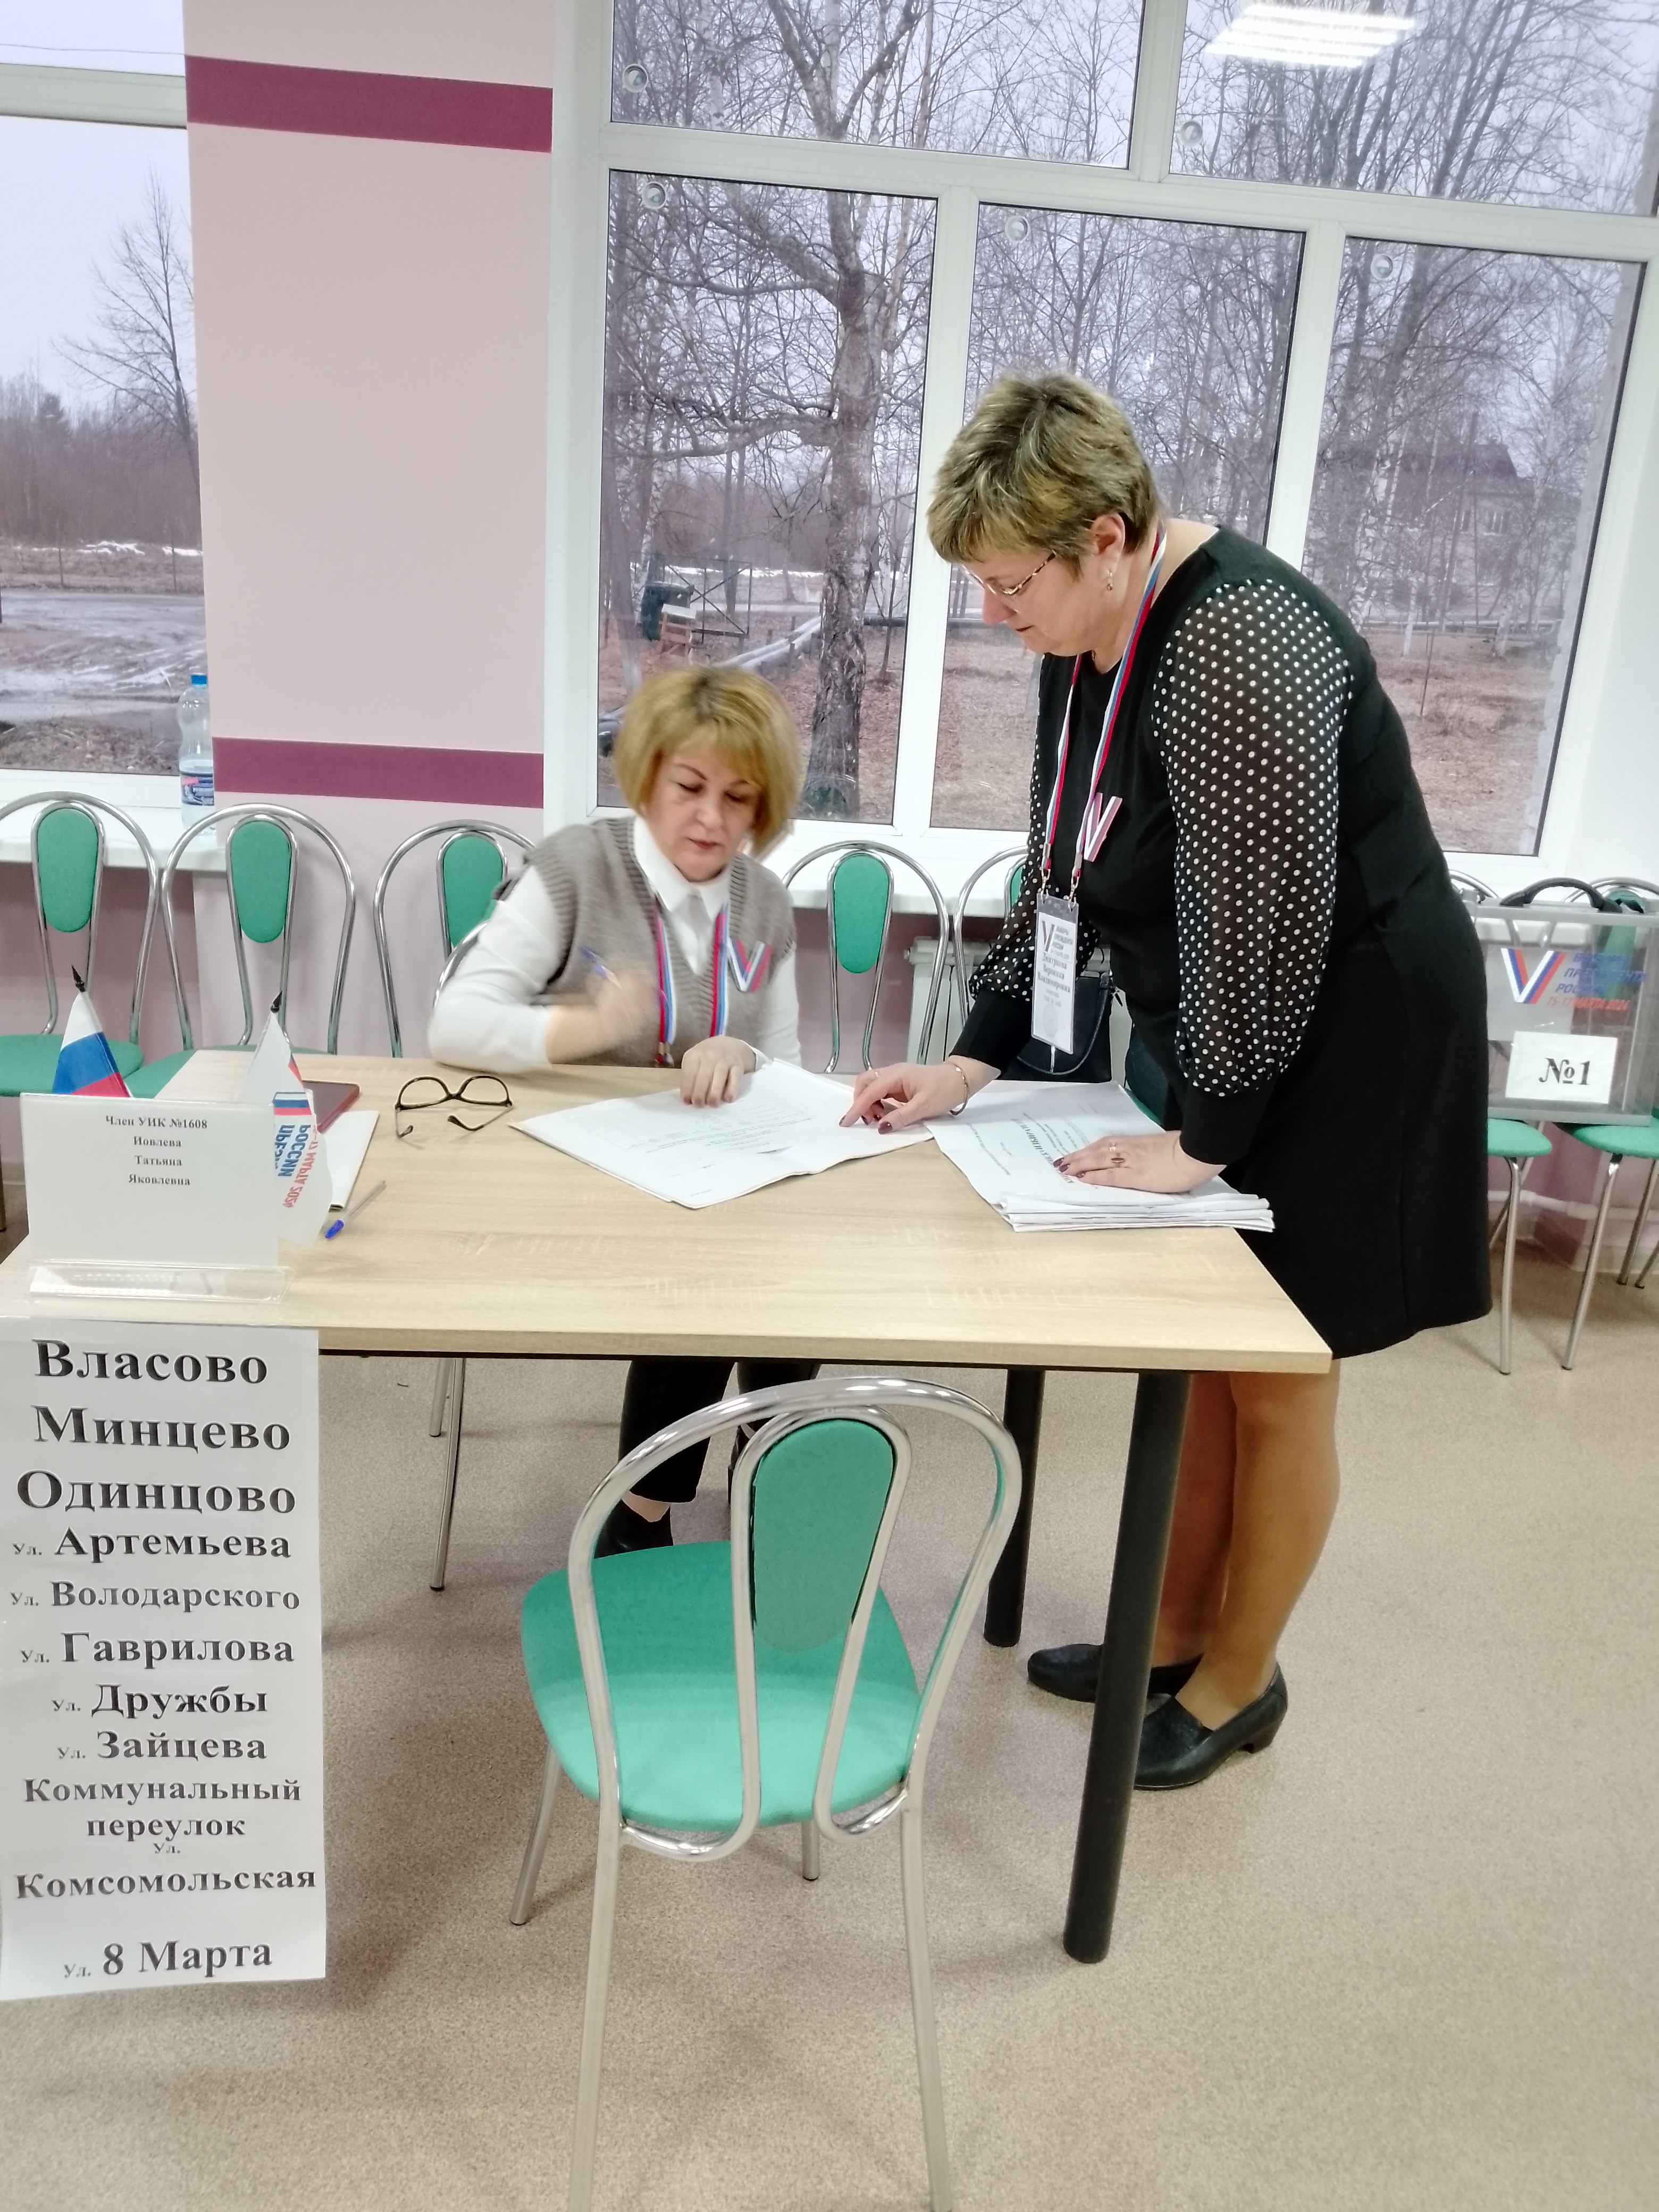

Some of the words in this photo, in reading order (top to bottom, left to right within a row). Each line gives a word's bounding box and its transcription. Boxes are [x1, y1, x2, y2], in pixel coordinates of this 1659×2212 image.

[1538, 1057, 1590, 1085] №1
[106, 1116, 134, 1126] Член
[138, 1117, 166, 1127] УИК
[170, 1118, 208, 1129] №1608
[134, 1136, 182, 1147] Иовлева
[135, 1155, 182, 1166] Татьяна
[129, 1174, 190, 1186] Яковлевна
[32, 1338, 267, 1384] Власово
[30, 1405, 290, 1453] Минцево
[17, 1470, 296, 1513] Одинцово
[13, 1543, 43, 1556] Ул.
[54, 1527, 291, 1563] Артемьева
[10, 1592, 39, 1606] Ул.
[51, 1581, 300, 1613] Володарского
[21, 1650, 50, 1663] Ул.
[61, 1631, 295, 1669] Гаврилова
[52, 1699, 81, 1712] Ул.
[91, 1684, 267, 1719] Дружбы
[58, 1747, 86, 1759] Ул.
[97, 1731, 267, 1761] Зайцева
[24, 1778, 301, 1805] Коммунальный
[87, 1819, 246, 1841] переулок
[153, 1843, 181, 1854] Ул.
[16, 1870, 316, 1899] Комсомольская
[64, 1964, 91, 1978] Ул.
[103, 1942, 124, 1975] 8
[139, 1940, 272, 1977] Марта
